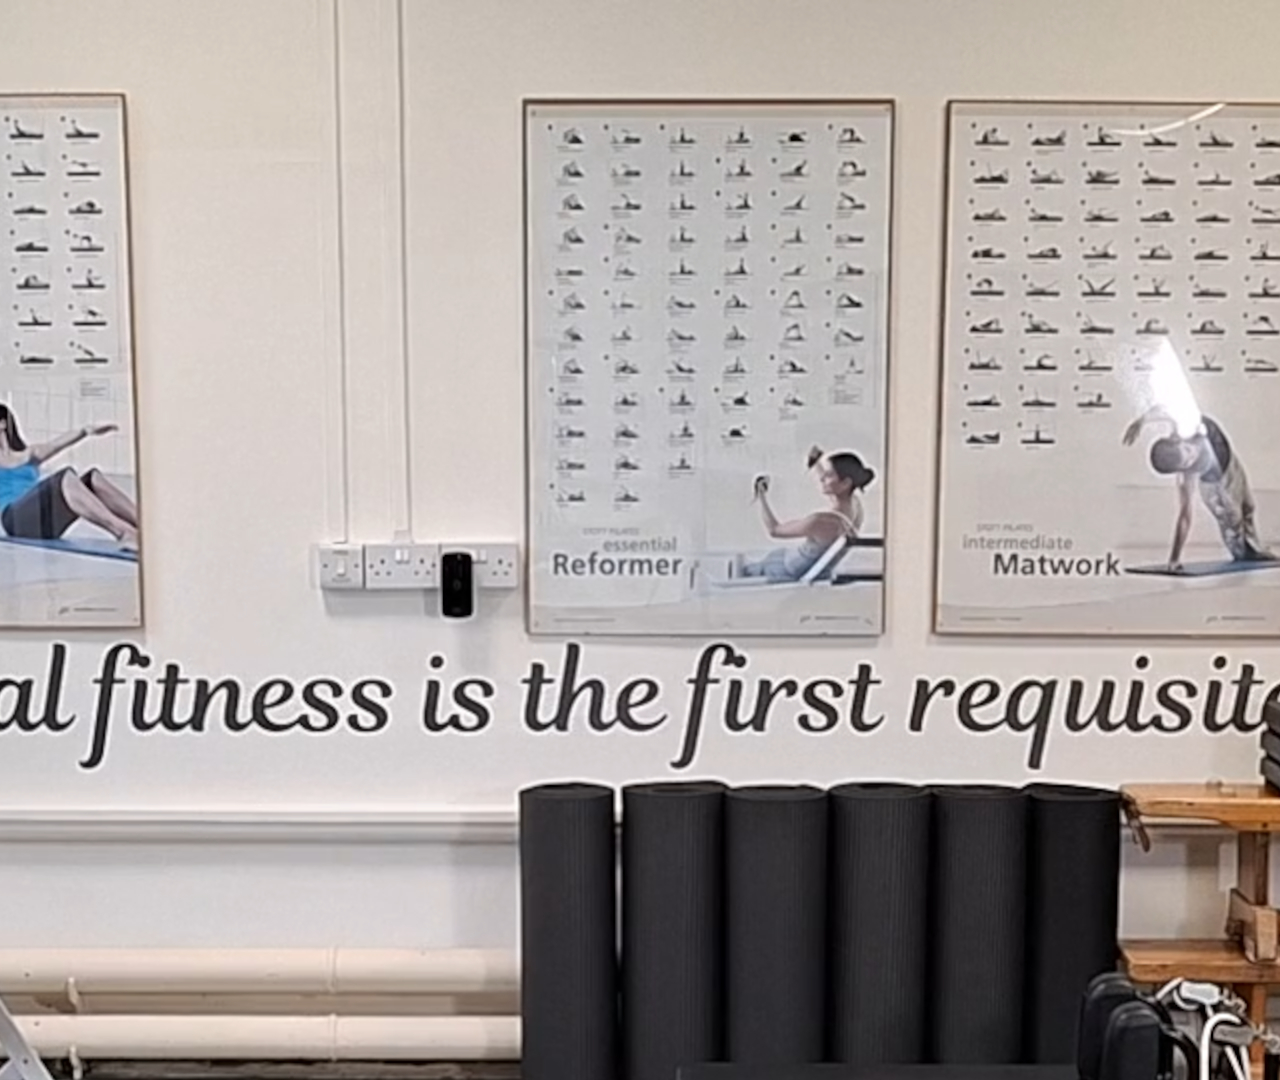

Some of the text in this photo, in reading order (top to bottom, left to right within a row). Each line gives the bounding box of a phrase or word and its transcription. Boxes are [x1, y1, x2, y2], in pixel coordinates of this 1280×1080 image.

[603, 536, 677, 552] essential
[962, 534, 1073, 550] intermediate
[553, 551, 683, 576] Reformer
[993, 552, 1121, 576] Matwork
[79, 643, 394, 768] fitness
[422, 655, 495, 732] is
[521, 642, 668, 732] the
[669, 643, 885, 768] first
